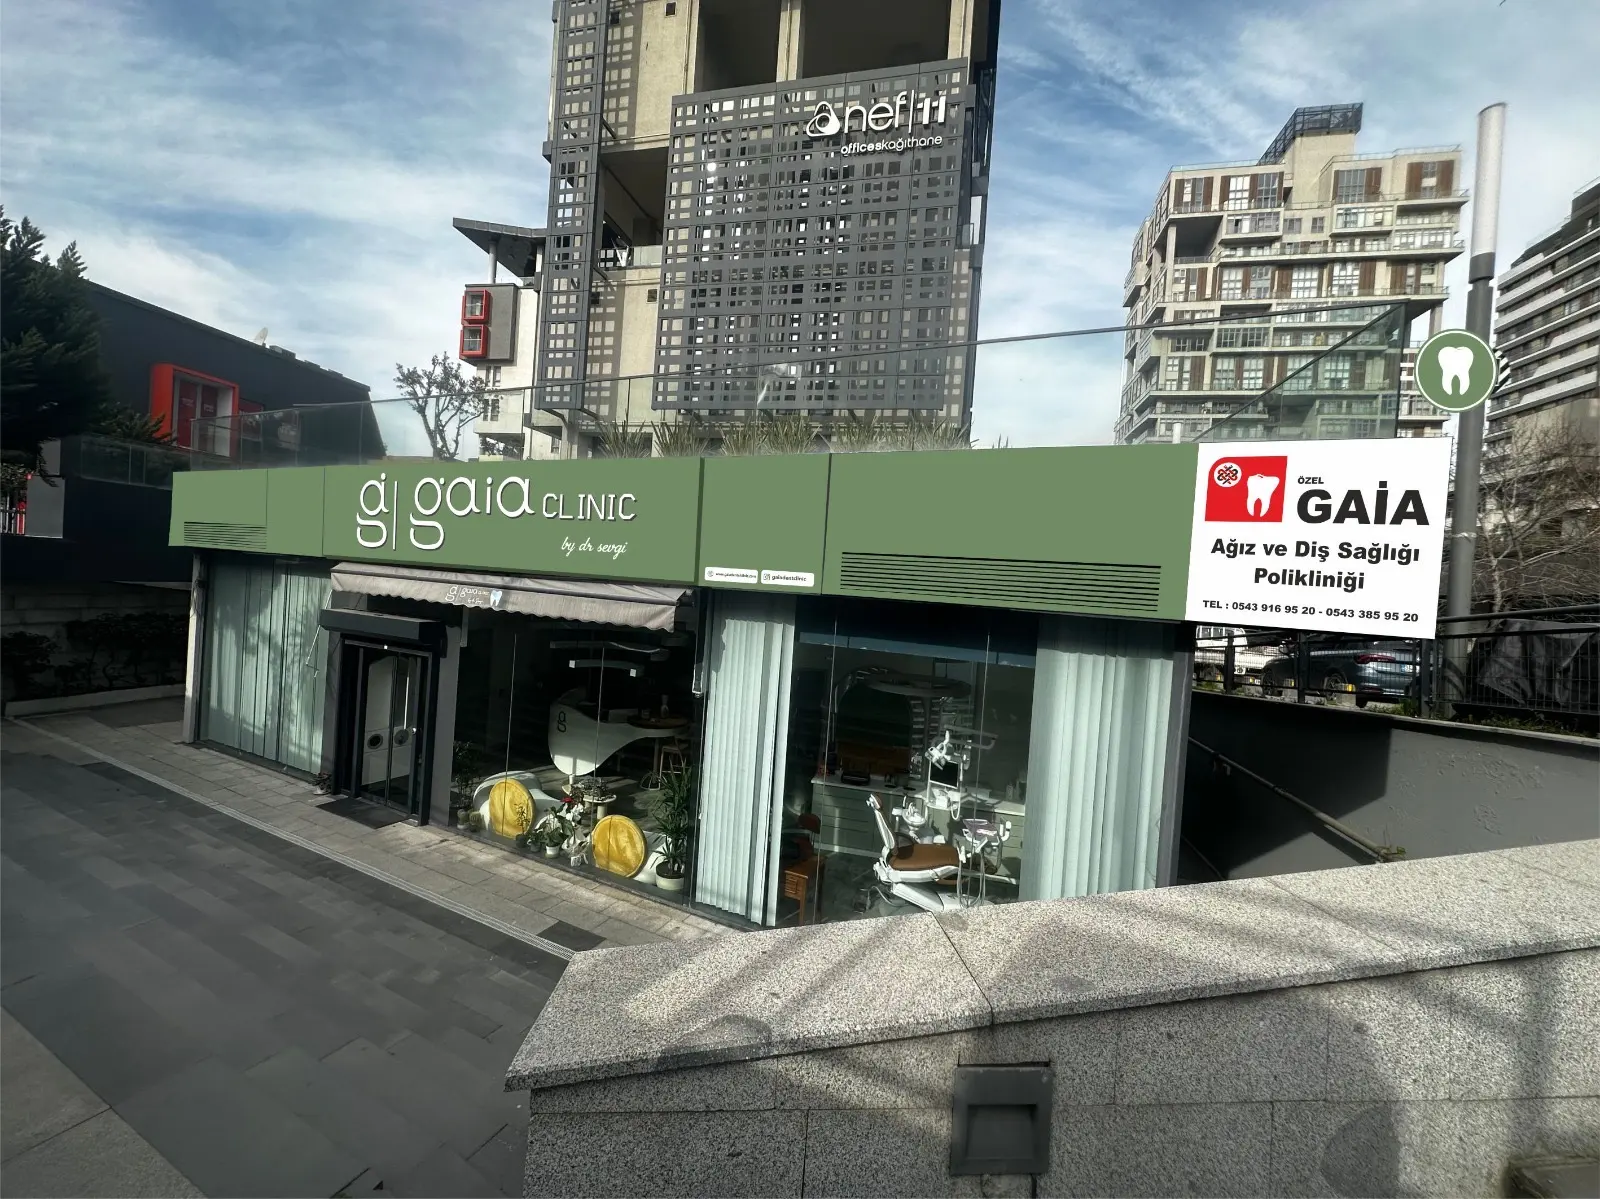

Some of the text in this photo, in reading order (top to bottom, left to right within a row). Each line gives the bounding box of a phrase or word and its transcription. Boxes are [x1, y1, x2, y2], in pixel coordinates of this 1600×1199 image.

[1297, 475, 1325, 485] ÖZEL
[410, 476, 535, 550] gaia
[542, 493, 637, 521] CLINIC
[1296, 480, 1430, 526] GAİA
[561, 536, 628, 560] by dr sevgi
[1211, 538, 1420, 566] Ağız ve Diş Sağlığı
[1254, 567, 1365, 593] Polikliniği
[1203, 600, 1223, 609] TEL
[1231, 601, 1258, 611] 0543
[1261, 603, 1281, 613] 916
[1284, 605, 1298, 614] 95
[1301, 606, 1316, 615] 20
[1325, 608, 1355, 618] 0543
[1358, 610, 1380, 619] 385
[1384, 612, 1399, 621] 95
[1403, 613, 1419, 622] 20
